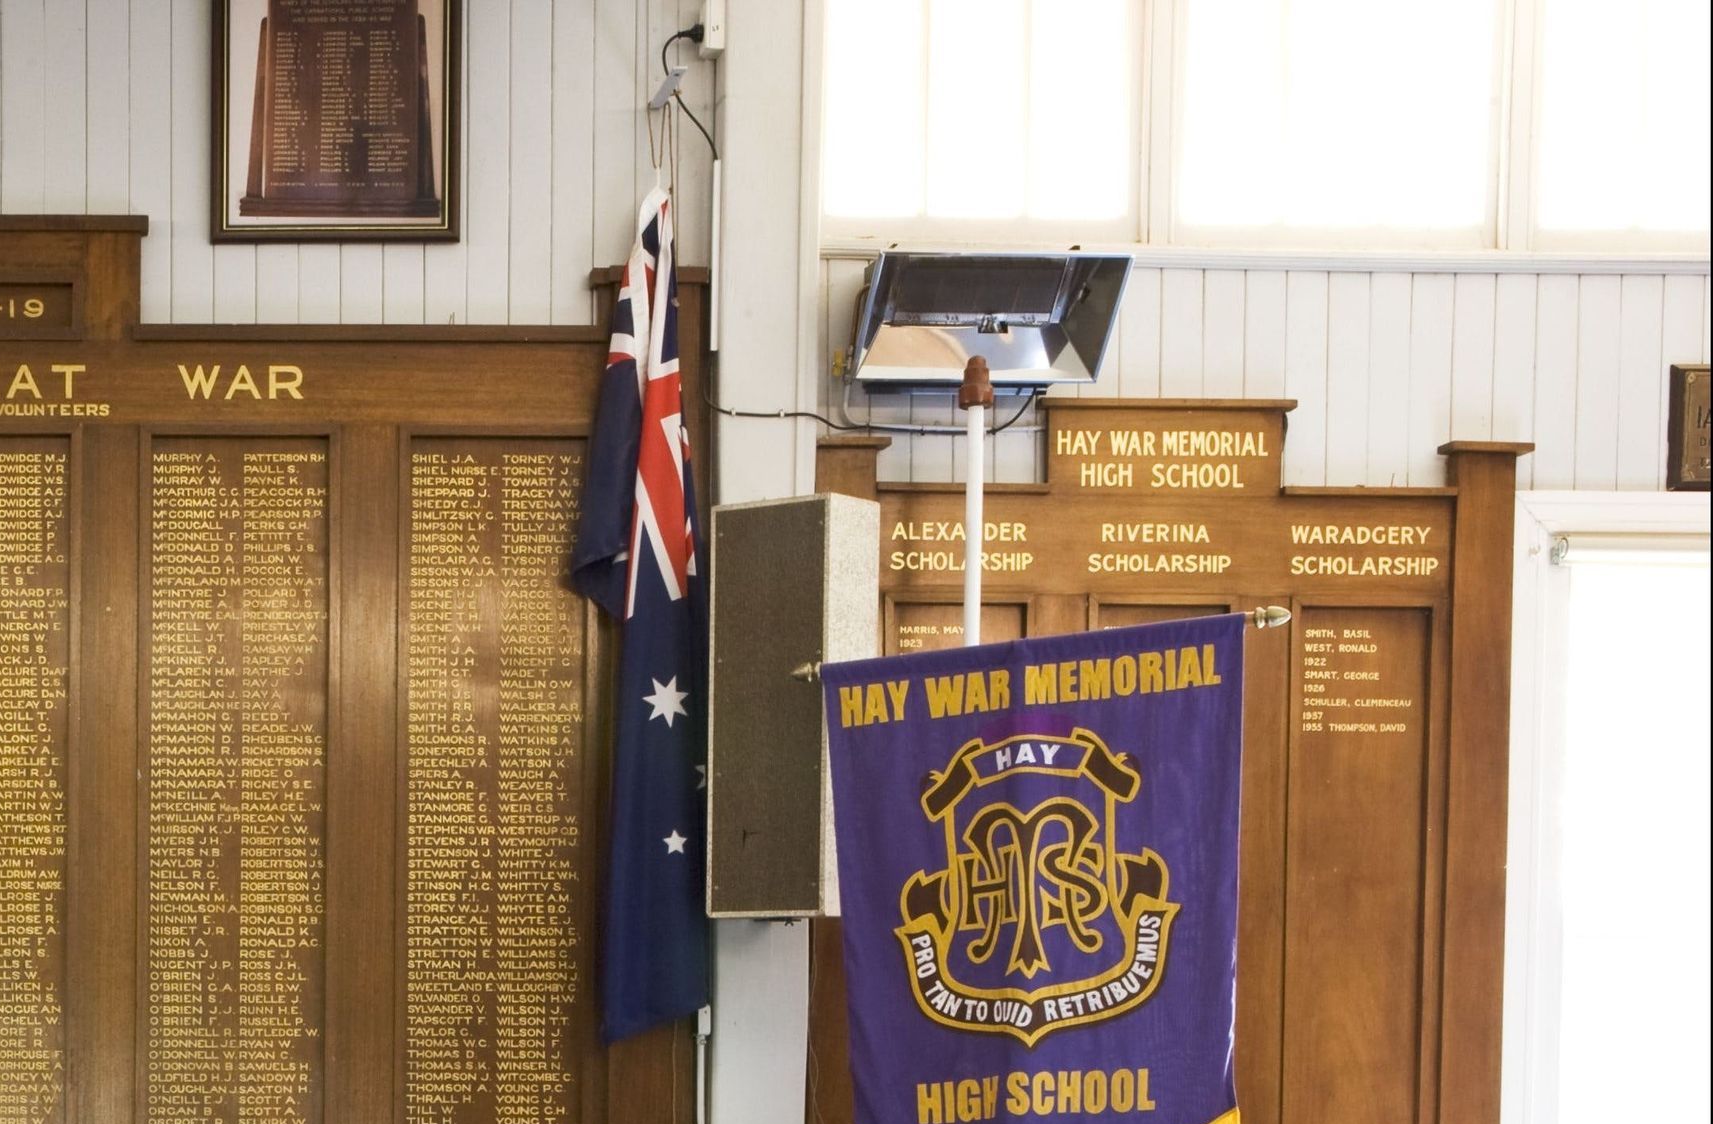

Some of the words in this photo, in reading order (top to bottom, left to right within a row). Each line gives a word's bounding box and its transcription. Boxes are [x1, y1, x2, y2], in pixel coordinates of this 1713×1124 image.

[178, 365, 303, 399] WAR
[1058, 431, 1101, 455] HAY
[1110, 431, 1155, 456] WAR
[1163, 431, 1268, 456] MEMORIAL
[153, 464, 204, 474] MURPHY
[243, 464, 285, 474] PAULL
[1081, 463, 1132, 486] HIGH
[1151, 464, 1243, 487] SCHOOL
[412, 476, 475, 486] SHEPPARD
[893, 522, 1027, 541] ALEXADER
[1102, 524, 1209, 542] RIVERINA
[1292, 526, 1431, 544] WARADGERY
[1088, 554, 1231, 572] SCHOLARSHIP
[1291, 557, 1438, 575] SCHOLARSHIP
[942, 625, 965, 635] MAY
[1343, 629, 1372, 639] BASIL
[899, 639, 924, 648] 1923
[1338, 643, 1378, 653] RONALD
[1304, 657, 1327, 667] 1922
[1343, 671, 1380, 681] GEORGE
[839, 680, 910, 728] HAY
[925, 668, 1010, 719] WAR
[1024, 644, 1221, 706] MEMORIAL
[1354, 698, 1412, 708] CLEMENCEAU
[1379, 723, 1407, 733] DAVID
[996, 743, 1060, 772] HAY
[149, 881, 205, 891] NELSON
[239, 949, 276, 959] ROSE
[912, 934, 937, 979] PRO
[1043, 913, 1162, 1021] RETRIBUEMUS
[495, 1061, 547, 1071] WINSER
[917, 1075, 998, 1124] HIGH
[1006, 1068, 1156, 1115] SCHOOL
[406, 1105, 437, 1115] TILL
